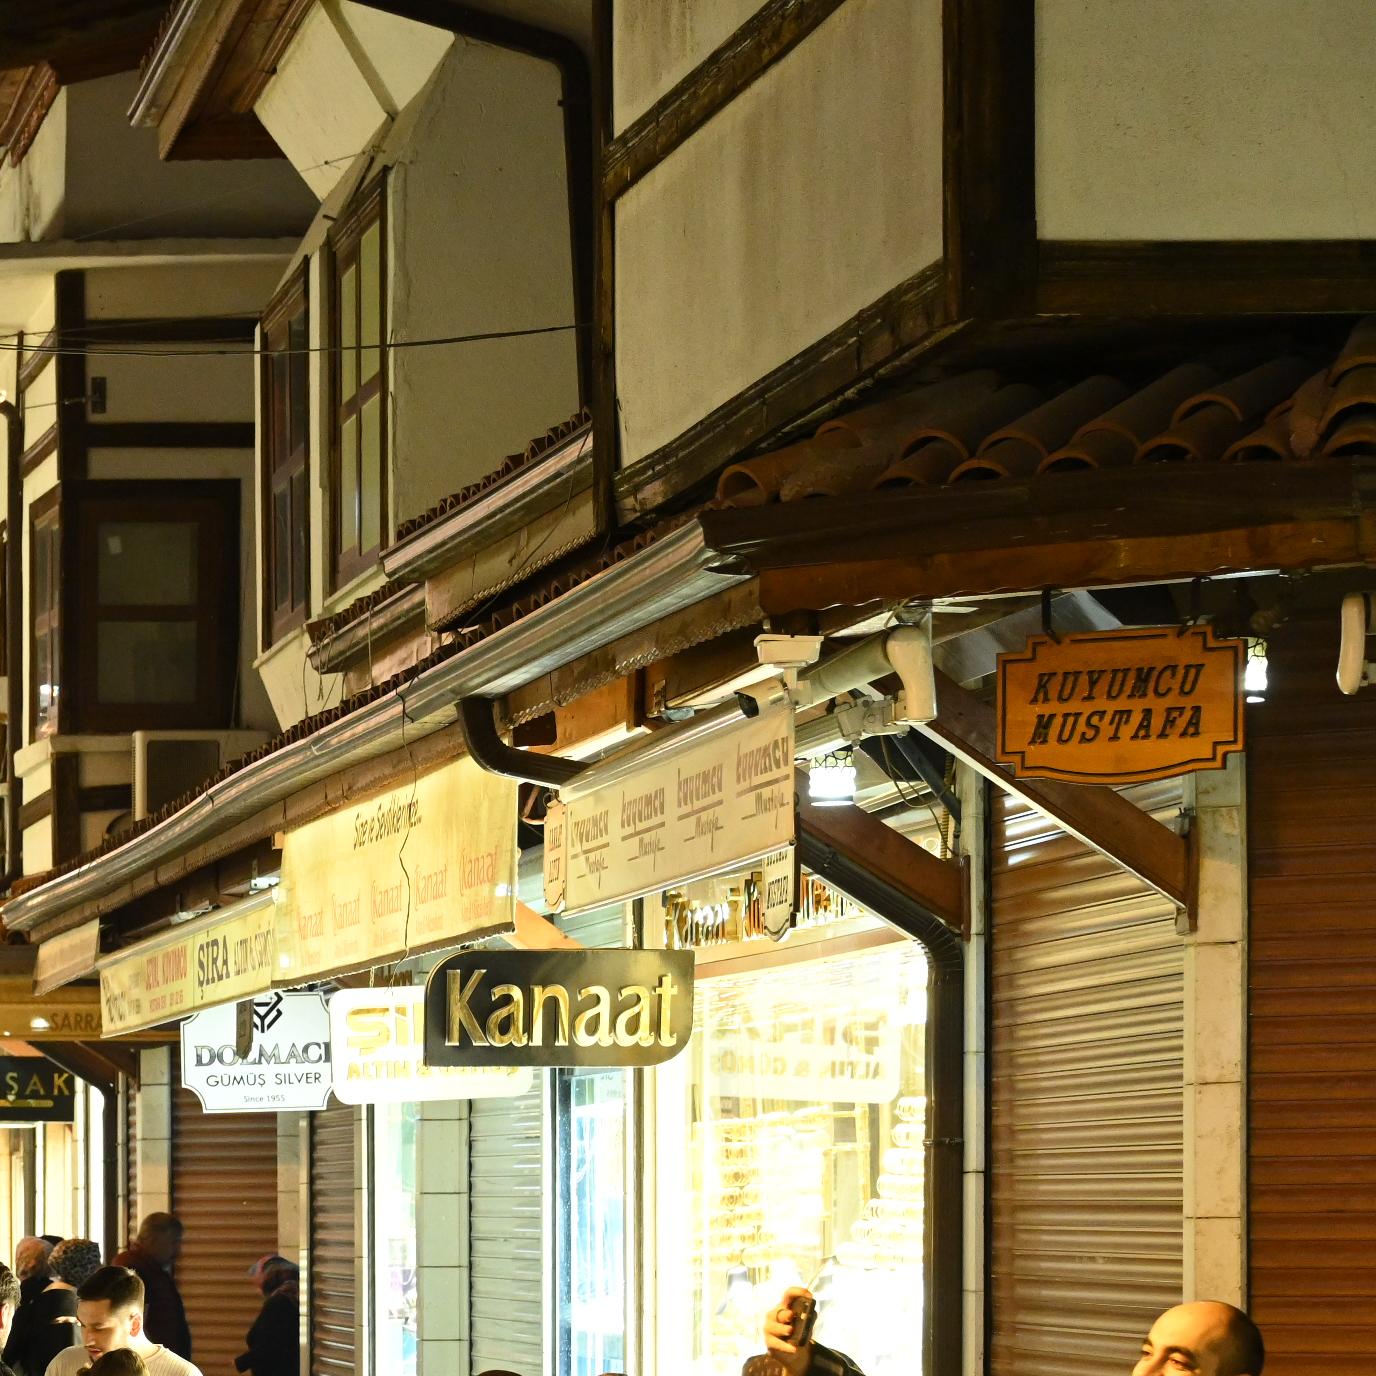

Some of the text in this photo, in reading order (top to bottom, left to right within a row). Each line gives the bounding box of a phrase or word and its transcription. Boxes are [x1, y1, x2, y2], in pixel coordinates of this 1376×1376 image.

[1029, 663, 1205, 704] KUYUMCU
[1028, 706, 1202, 745] MUSTAFA
[446, 967, 680, 1048] Kanaat
[206, 1071, 322, 1088] GÜMÜŞ SILVER
[243, 1094, 285, 1103] Since 1955
